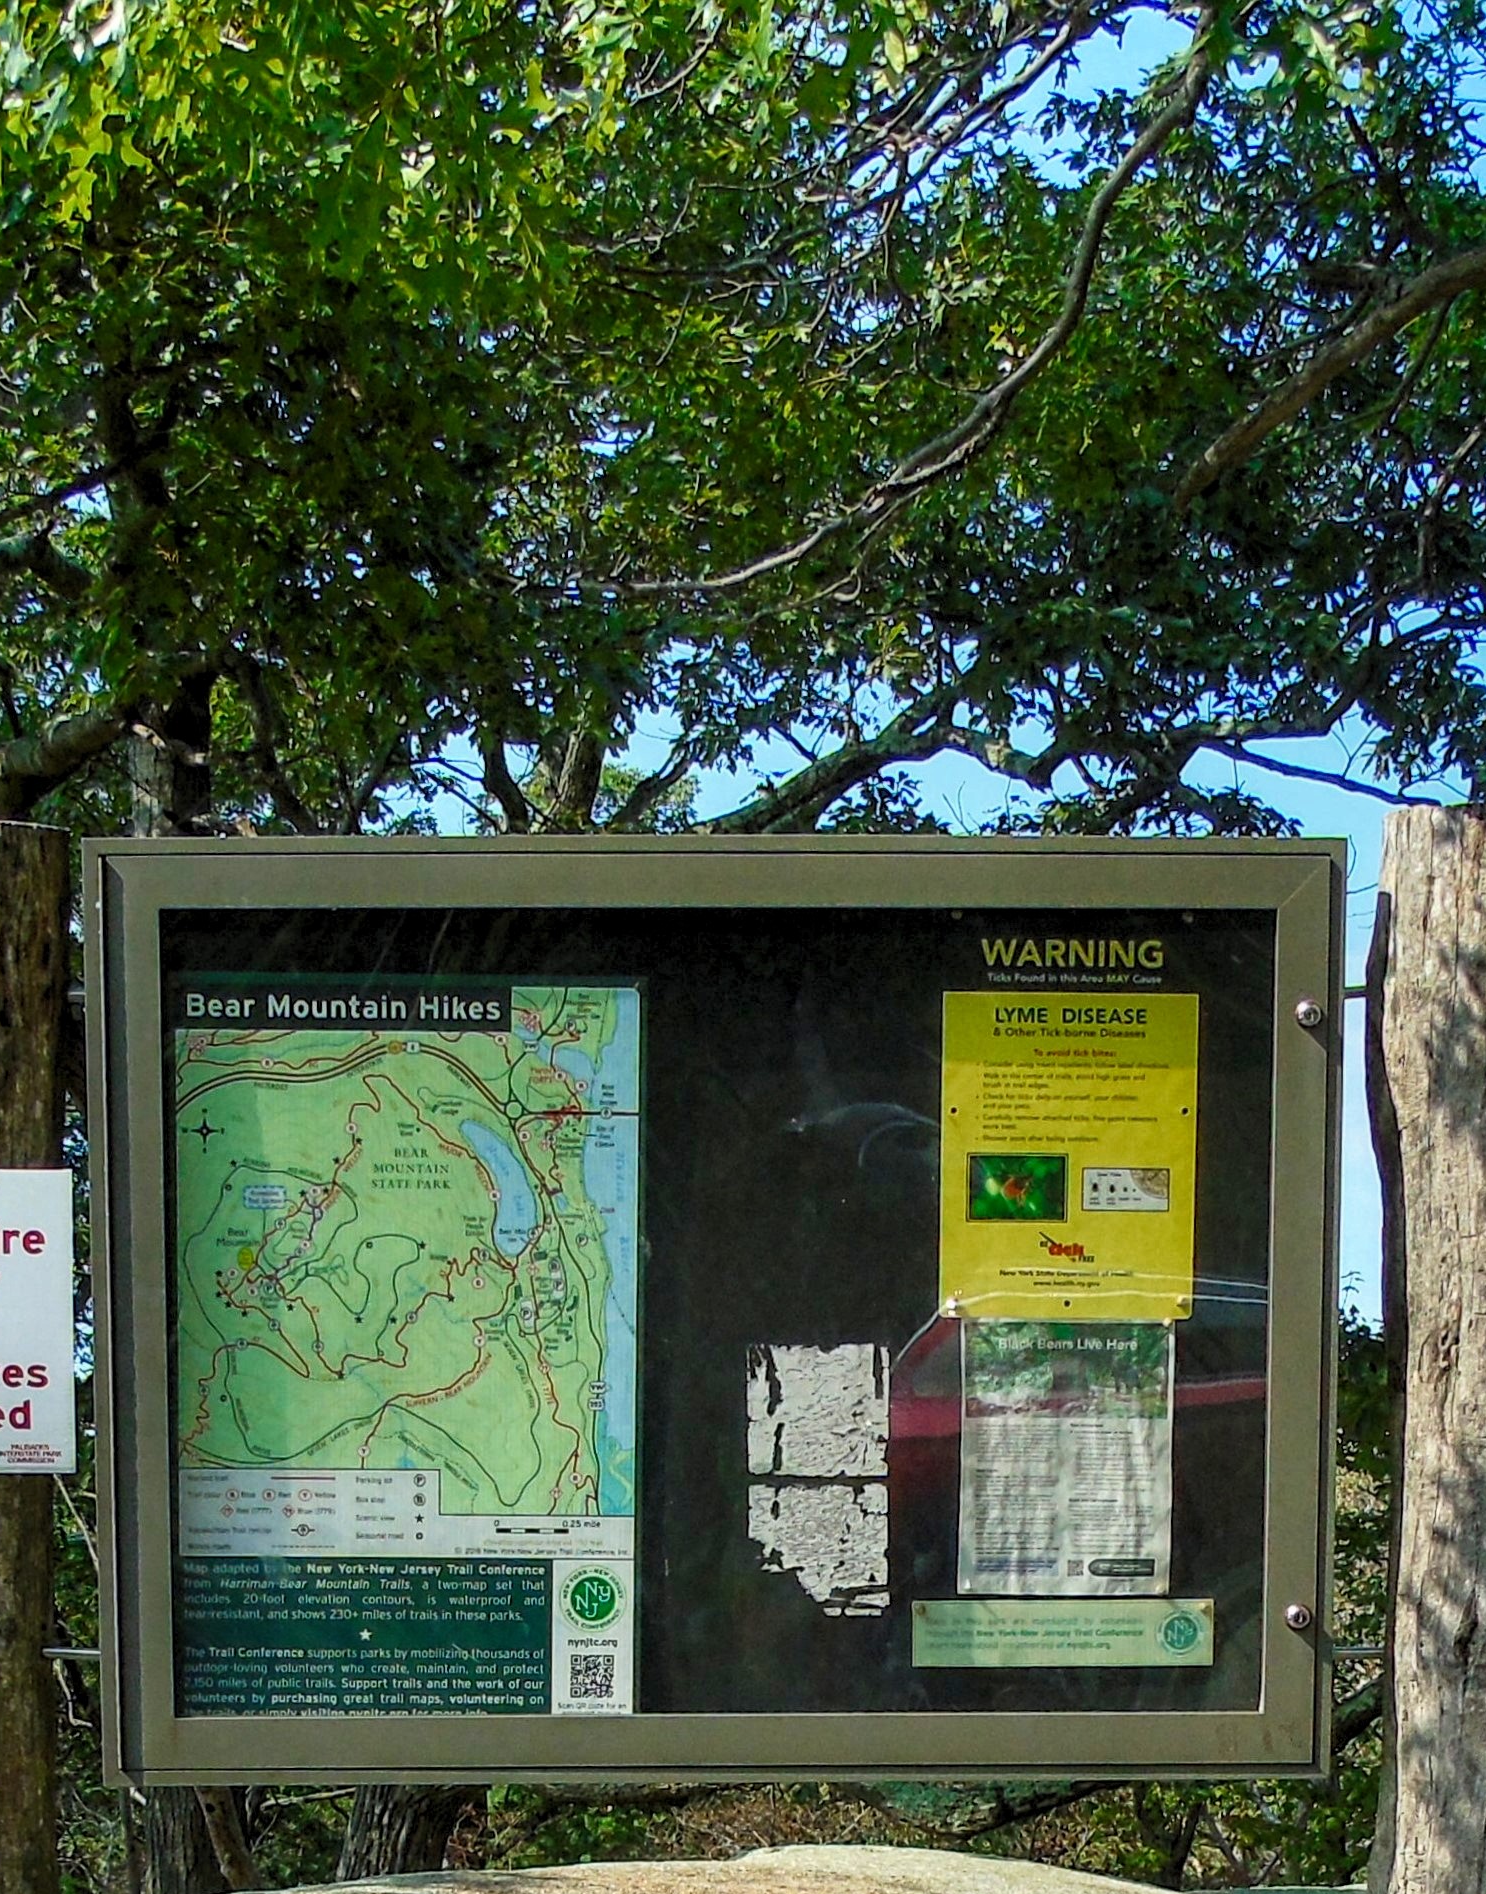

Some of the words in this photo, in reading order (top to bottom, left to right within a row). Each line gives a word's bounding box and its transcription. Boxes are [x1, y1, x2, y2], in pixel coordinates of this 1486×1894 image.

[981, 938, 1164, 969] WARNING
[987, 972, 1012, 983] Ticks
[1014, 973, 1046, 983] Found
[1048, 973, 1057, 983] in
[1060, 973, 1077, 983] this
[1080, 974, 1103, 983] Area
[1106, 974, 1130, 984] MAY
[1132, 974, 1162, 984] Cause
[186, 993, 255, 1018] Bear
[267, 994, 407, 1020] Mountain
[419, 995, 502, 1021] Hikes
[995, 1007, 1048, 1024] LYME
[1062, 1008, 1147, 1025] DISEASE
[1005, 1027, 1036, 1037] Other
[1040, 1028, 1096, 1038] Tick-borne
[1099, 1028, 1146, 1039] Diseases
[1073, 1049, 1088, 1057] tick
[394, 1148, 429, 1159] BEAR
[373, 1163, 450, 1175] MOUNTAIN
[371, 1178, 409, 1190] STATE
[416, 1179, 452, 1190] PARK
[227, 1227, 248, 1237] Bear
[216, 1237, 260, 1247] Mountain
[998, 1336, 1033, 1350] Black
[1037, 1338, 1074, 1350] Bears
[1077, 1338, 1103, 1350] Live
[1106, 1337, 1138, 1351] Here
[494, 1519, 500, 1527] 0
[562, 1520, 582, 1528] 0.25
[583, 1520, 601, 1528] mile
[213, 1564, 259, 1576] adapted
[307, 1564, 333, 1575] New
[338, 1564, 395, 1575] York-New
[401, 1564, 442, 1577] Jersey
[447, 1564, 473, 1575] Trail
[479, 1564, 546, 1575] Conference
[220, 1579, 307, 1590] Harriman-Bear
[316, 1579, 370, 1590] Mountain
[380, 1579, 413, 1591] Trails,
[422, 1581, 429, 1590] a
[438, 1580, 488, 1593] two-map
[495, 1580, 513, 1590] set
[522, 1580, 545, 1590] that
[243, 1594, 285, 1605] 20-foot
[297, 1594, 351, 1605] elevation
[362, 1595, 415, 1607] contours,
[427, 1595, 437, 1605] is
[449, 1595, 512, 1608] waterproof
[524, 1595, 545, 1606] and
[267, 1609, 289, 1620] and
[291, 1609, 327, 1620] shows
[329, 1609, 358, 1620] 230+
[362, 1609, 392, 1620] miles
[395, 1609, 407, 1620] of
[410, 1609, 438, 1620] trails
[442, 1609, 452, 1620] in
[455, 1609, 487, 1620] these
[489, 1610, 524, 1623] parks.
[567, 1638, 618, 1648] nynjtc.org
[209, 1648, 235, 1658] Trail
[238, 1648, 305, 1658] Conference
[307, 1648, 357, 1661] supports
[360, 1648, 392, 1661] parks
[394, 1648, 407, 1661] by
[410, 1648, 469, 1661] mobilizing
[471, 1648, 531, 1658] thousands
[532, 1648, 545, 1658] of
[274, 1663, 335, 1673] volunteers
[341, 1664, 364, 1673] who
[371, 1663, 410, 1675] create,
[416, 1663, 468, 1675] maintain,
[475, 1663, 497, 1673] and
[503, 1663, 544, 1676] protect
[218, 1679, 248, 1688] miles
[251, 1679, 263, 1688] of
[267, 1679, 301, 1691] public
[305, 1679, 336, 1688] trails.
[341, 1678, 388, 1691] Support
[392, 1679, 422, 1688] trails
[426, 1679, 448, 1688] and
[452, 1679, 472, 1688] the
[476, 1679, 504, 1688] work
[508, 1679, 521, 1688] of
[524, 1680, 545, 1690] our
[184, 1693, 246, 1703] volunteers
[251, 1693, 265, 1705] by
[271, 1693, 338, 1706] purchasing
[343, 1694, 374, 1706] great
[380, 1694, 404, 1704] trail
[410, 1694, 444, 1707] maps,
[449, 1694, 524, 1707] volunteering
[529, 1694, 545, 1704] on
